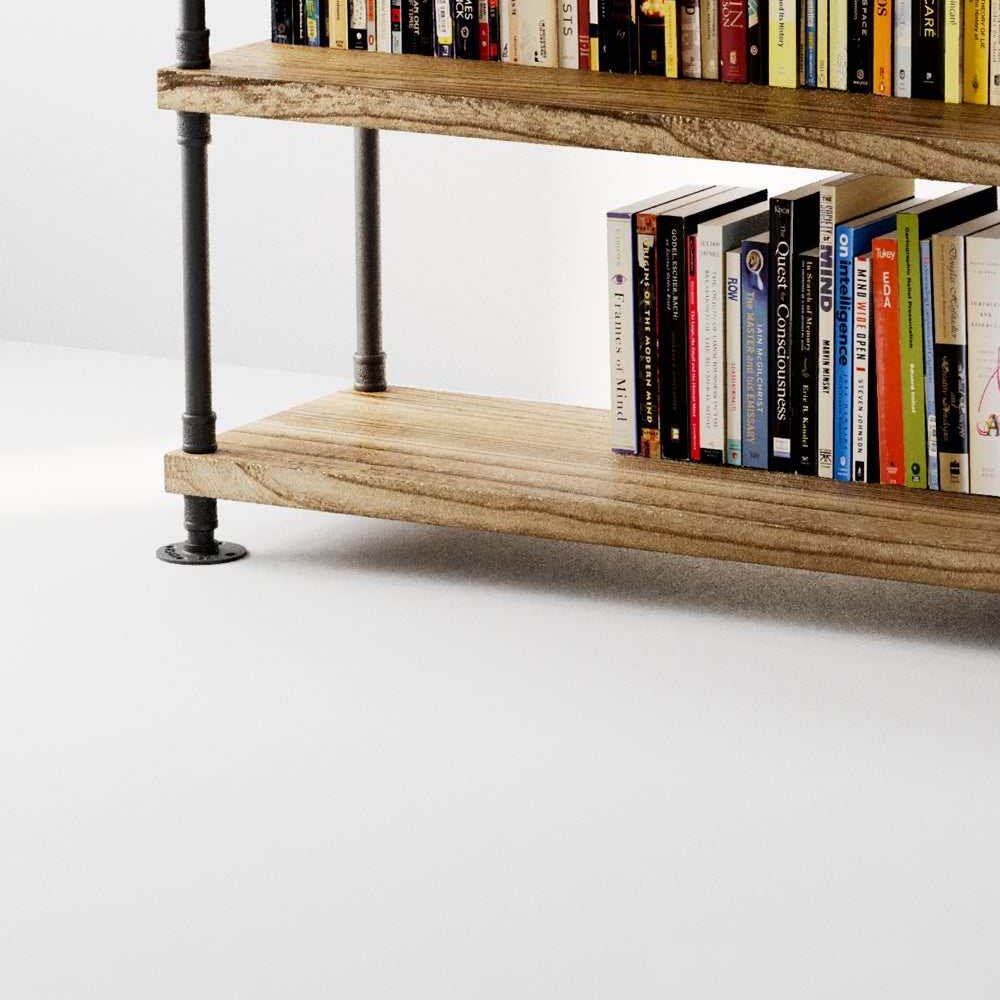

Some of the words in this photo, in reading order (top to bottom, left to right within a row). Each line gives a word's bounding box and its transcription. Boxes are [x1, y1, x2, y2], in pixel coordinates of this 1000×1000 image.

[821, 204, 832, 234] SOCIETY
[839, 234, 848, 257] on
[776, 241, 789, 289] Quest
[821, 244, 832, 312] MIND
[728, 277, 737, 301] FLOW
[856, 268, 866, 297] MIND
[615, 292, 626, 353] Frames
[836, 260, 851, 366] intelligence
[856, 302, 866, 328] WIDE
[856, 333, 866, 360] OPEN
[615, 358, 626, 372] of
[777, 304, 789, 420] Consciousness
[616, 378, 628, 420] Mind
